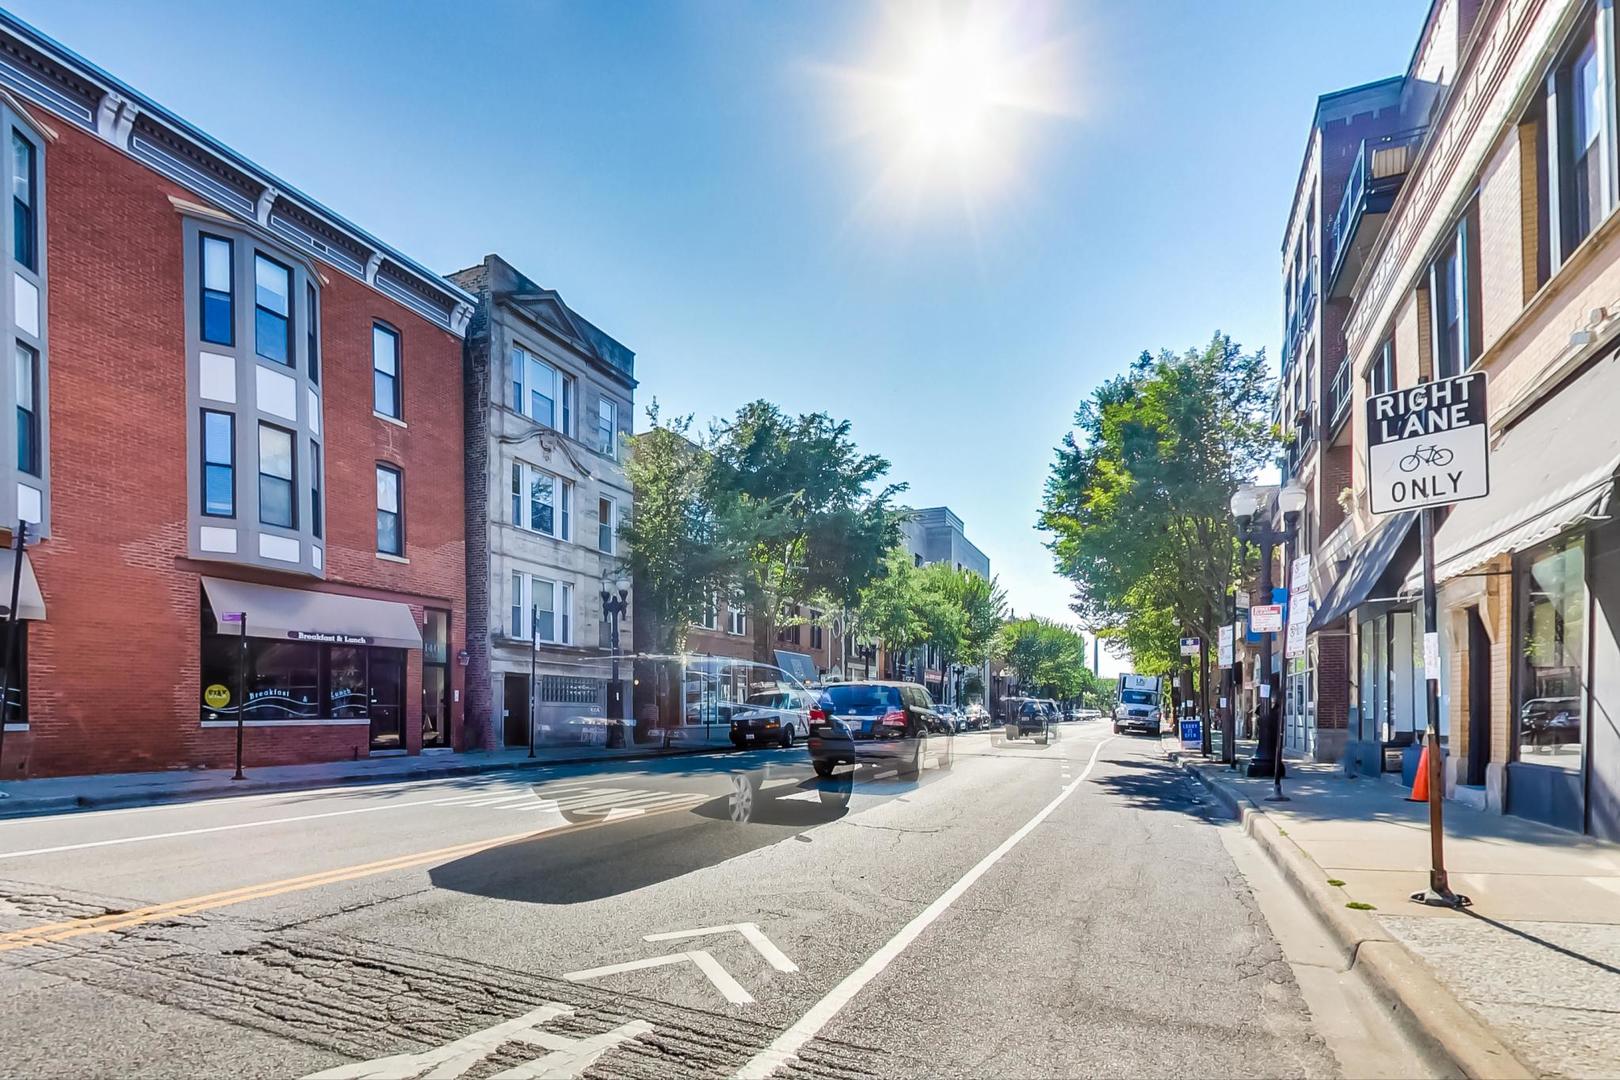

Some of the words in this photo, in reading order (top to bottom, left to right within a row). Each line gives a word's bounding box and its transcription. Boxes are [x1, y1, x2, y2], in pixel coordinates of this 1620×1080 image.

[1376, 376, 1474, 420] RIGHT
[1382, 402, 1470, 443] LANE
[1391, 470, 1464, 503] ONLY
[298, 631, 336, 642] Breakfast
[344, 635, 367, 644] Lunch
[249, 688, 290, 700] Breakfast
